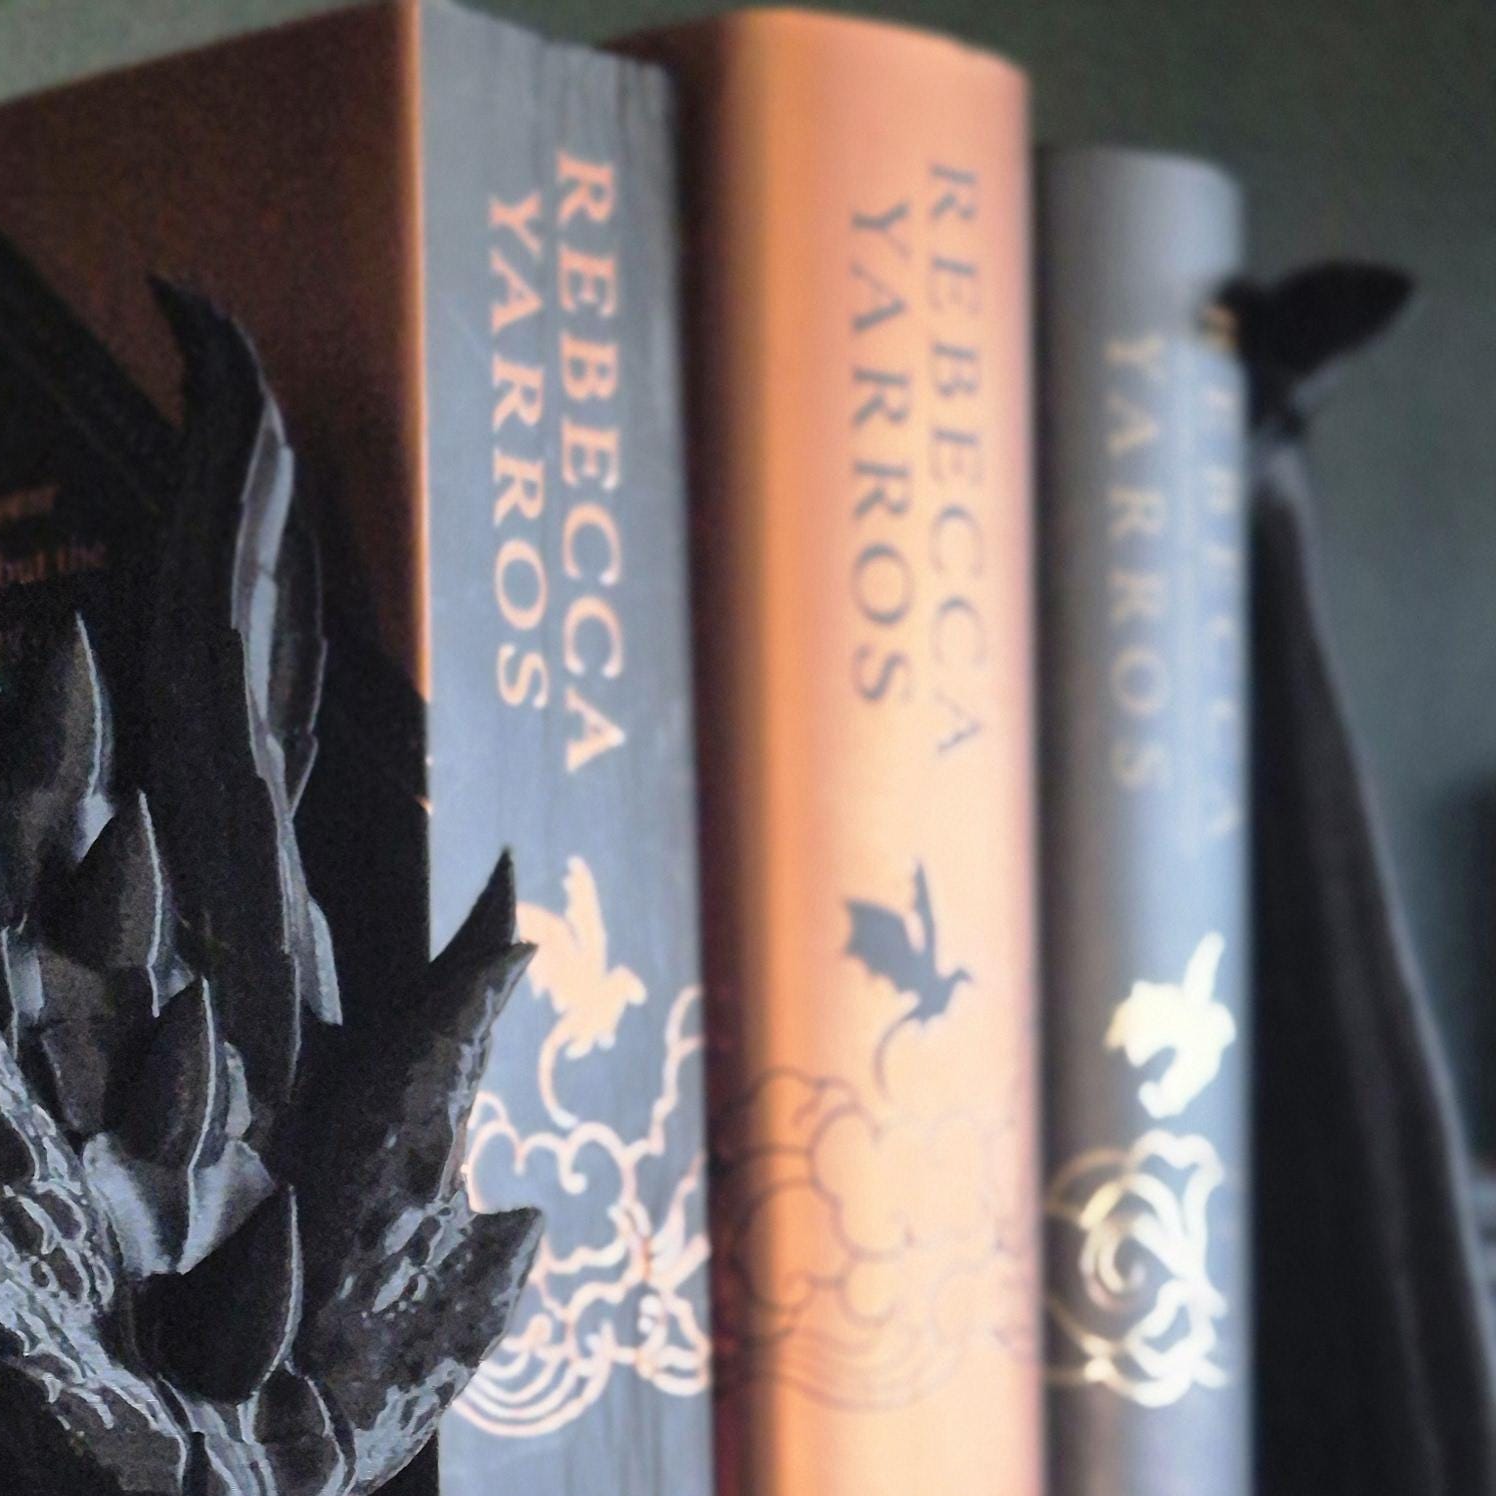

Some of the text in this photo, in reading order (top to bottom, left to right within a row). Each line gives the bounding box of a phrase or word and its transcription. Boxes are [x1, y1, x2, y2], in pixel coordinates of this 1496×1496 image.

[489, 192, 550, 711] YARROS
[556, 148, 626, 775] REBECCA
[850, 199, 912, 706] YARROS
[929, 161, 989, 758] REBECCA
